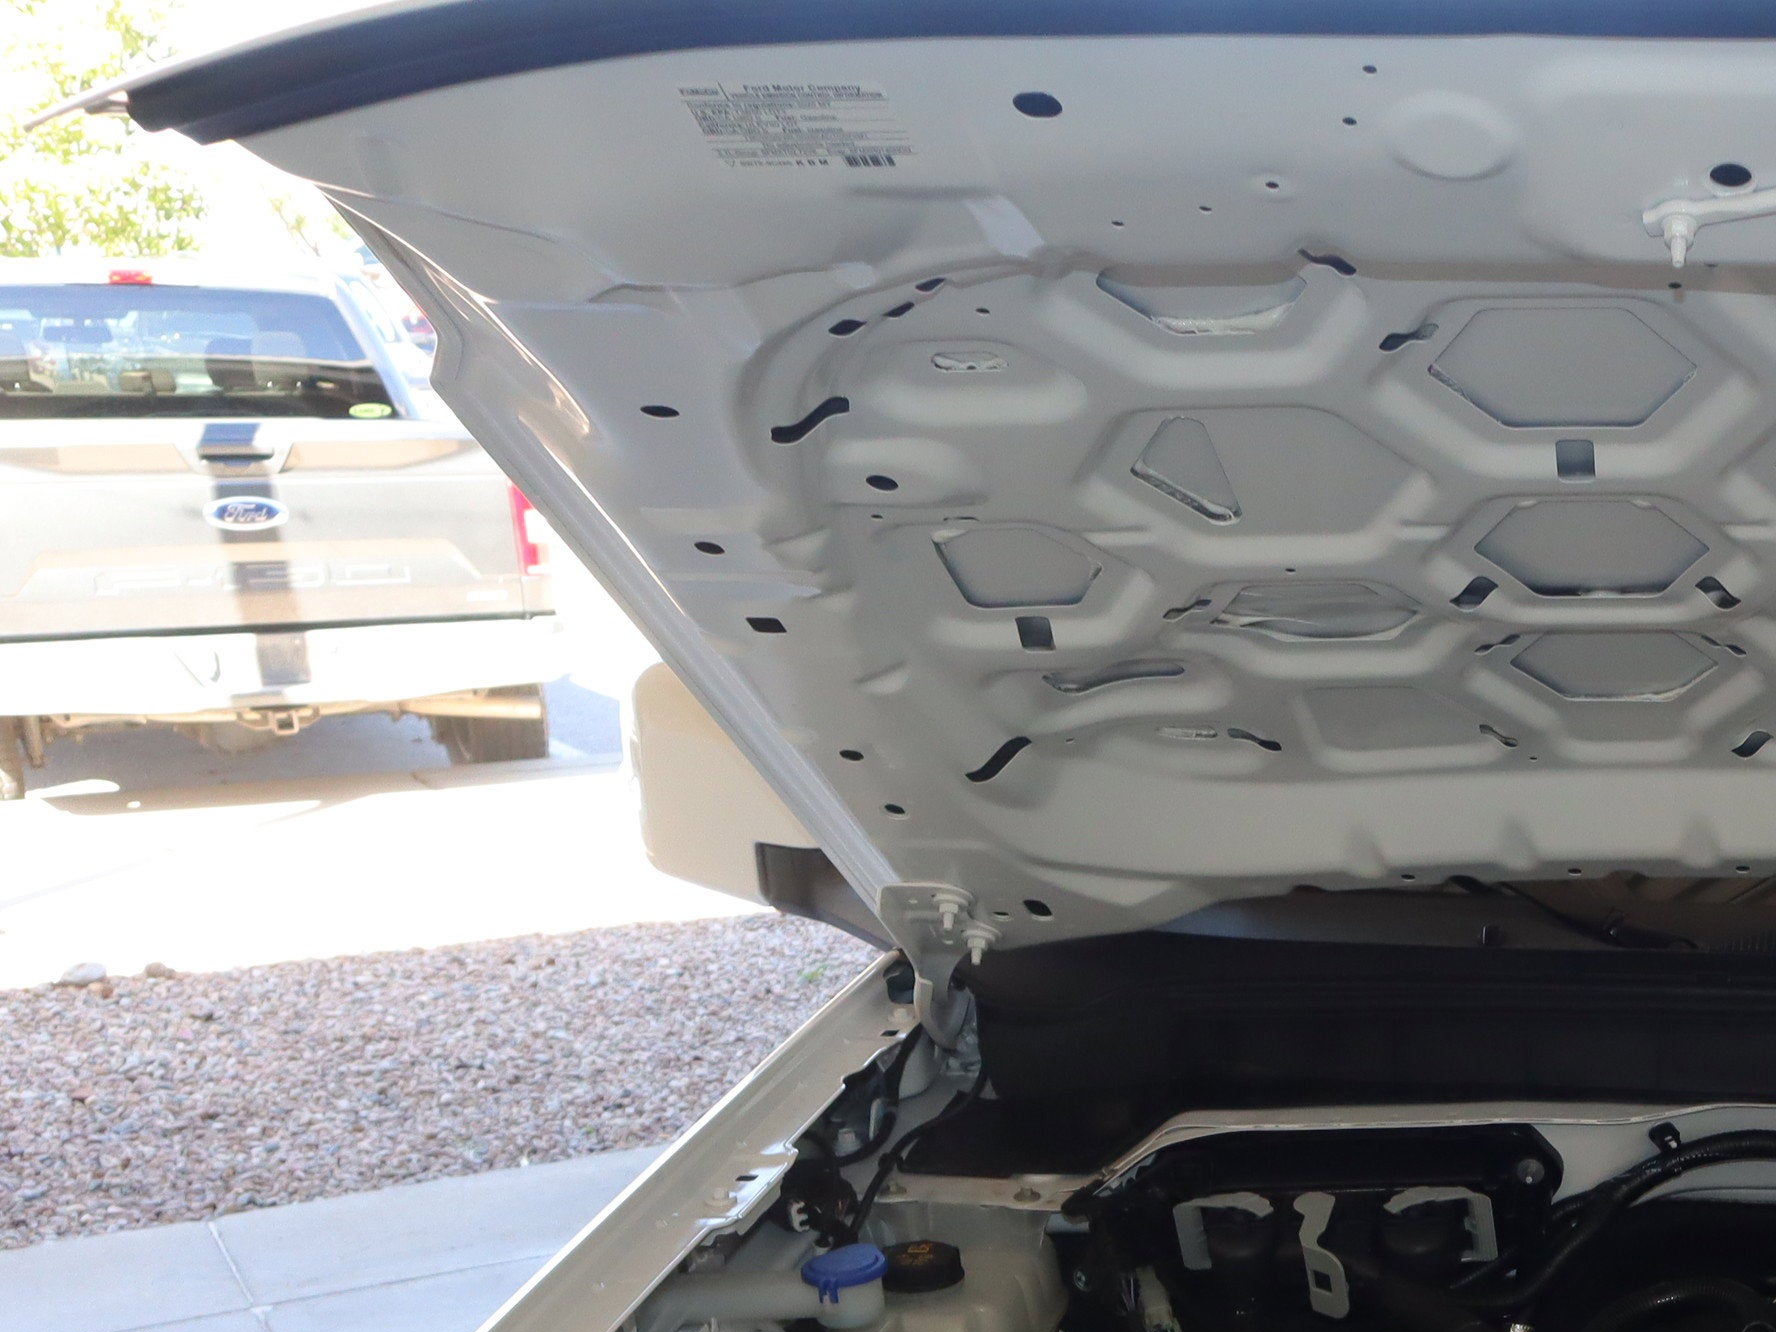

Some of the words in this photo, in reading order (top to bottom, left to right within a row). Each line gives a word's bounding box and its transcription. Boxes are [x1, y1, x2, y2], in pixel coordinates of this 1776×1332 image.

[742, 84, 769, 92] Ford
[772, 84, 804, 92] Motor
[807, 84, 860, 96] Company
[224, 503, 268, 522] Ford
